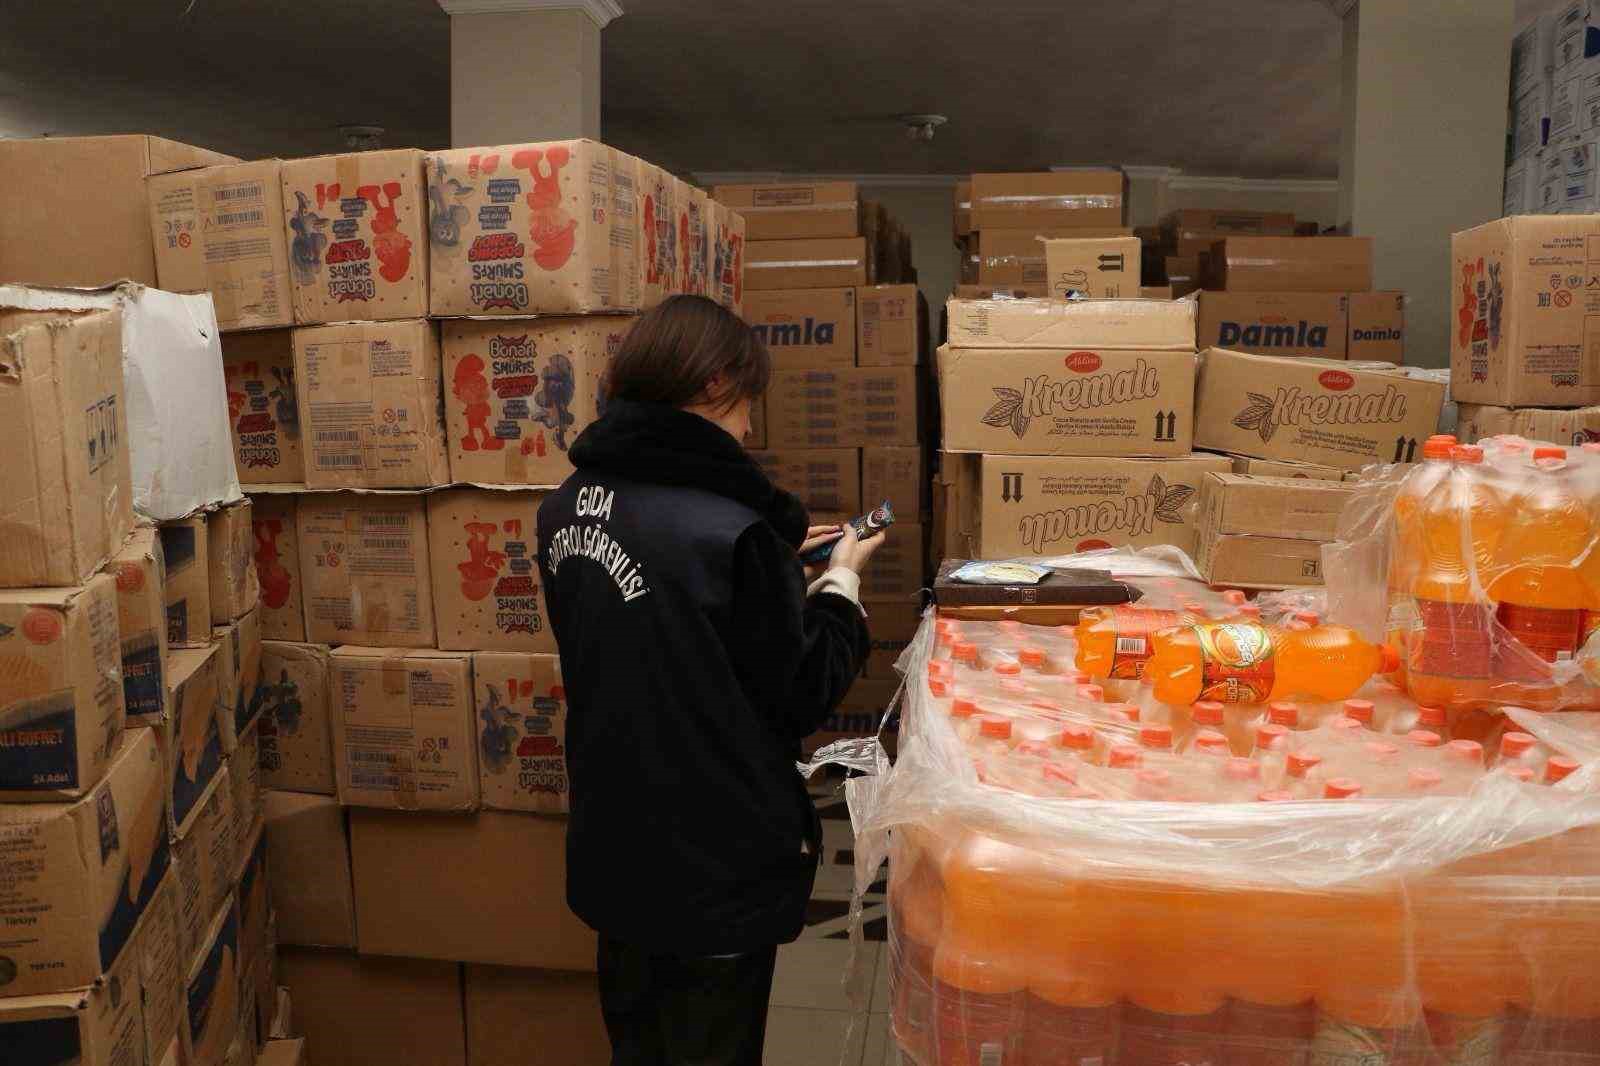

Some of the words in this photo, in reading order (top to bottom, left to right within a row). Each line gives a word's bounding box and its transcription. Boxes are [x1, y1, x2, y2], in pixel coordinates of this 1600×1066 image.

[751, 317, 834, 346] amla
[1218, 320, 1329, 348] Damla
[1353, 327, 1401, 341] Damla
[576, 485, 615, 521] GIDA
